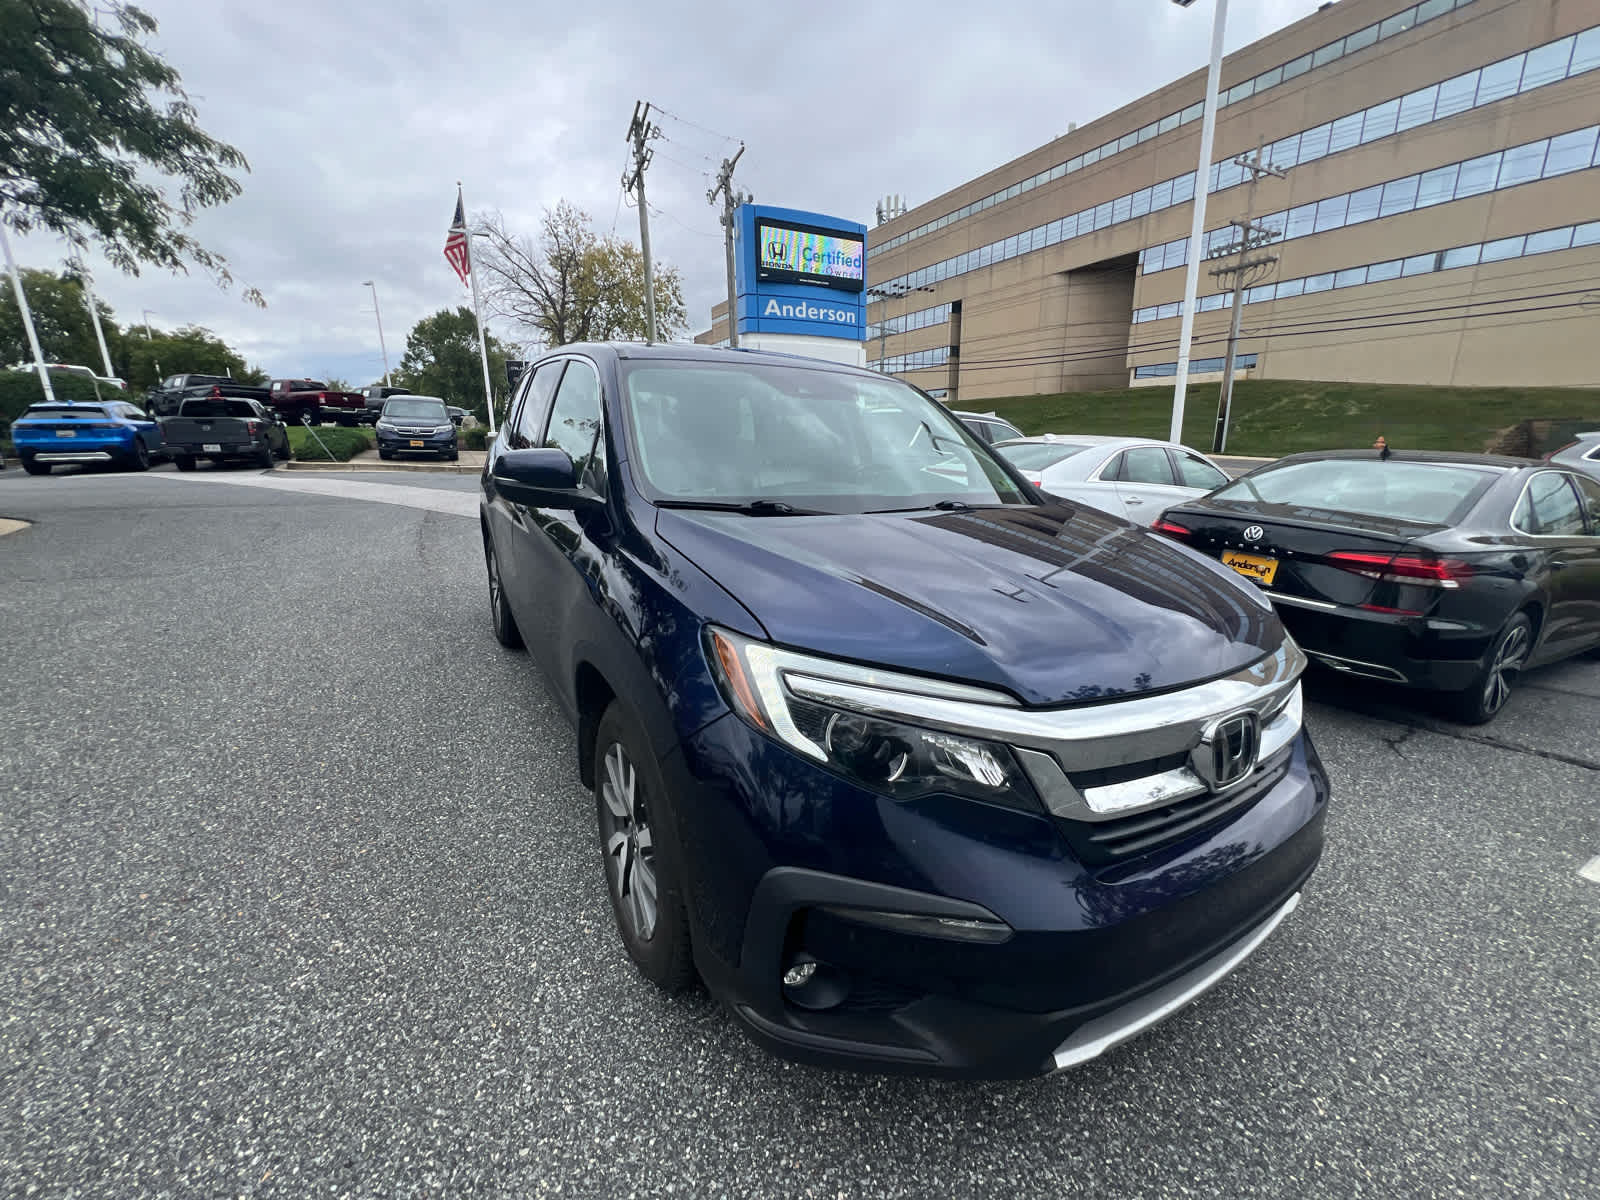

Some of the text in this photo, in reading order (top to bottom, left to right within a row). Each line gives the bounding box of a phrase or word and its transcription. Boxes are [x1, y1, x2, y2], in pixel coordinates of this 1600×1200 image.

[762, 261, 793, 269] HONDA
[802, 247, 862, 268] Certified
[764, 299, 856, 324] Anderson
